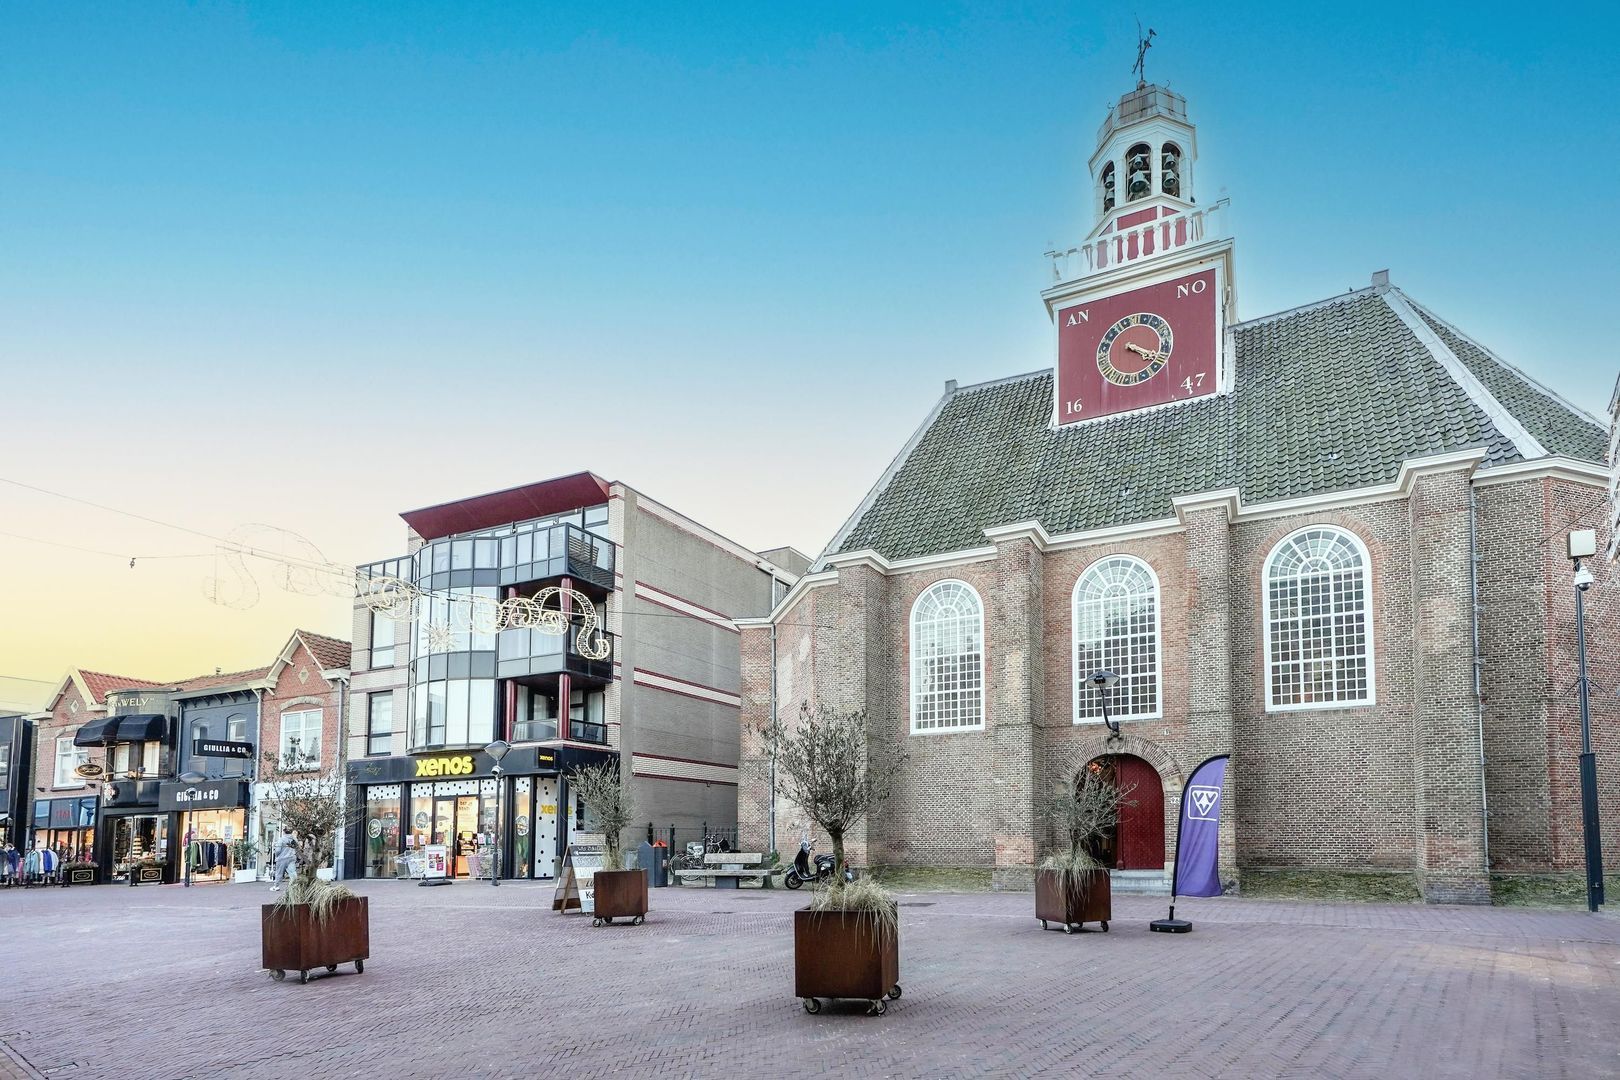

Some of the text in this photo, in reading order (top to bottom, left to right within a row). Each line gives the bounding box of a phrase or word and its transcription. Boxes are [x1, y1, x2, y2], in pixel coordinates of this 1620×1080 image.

[1065, 279, 1206, 327] AN NO
[1066, 372, 1206, 415] 16 47
[121, 697, 149, 707] WELY
[203, 744, 230, 753] GIULLIA
[415, 755, 473, 777] xenos
[176, 789, 219, 802] GIUIA & CO
